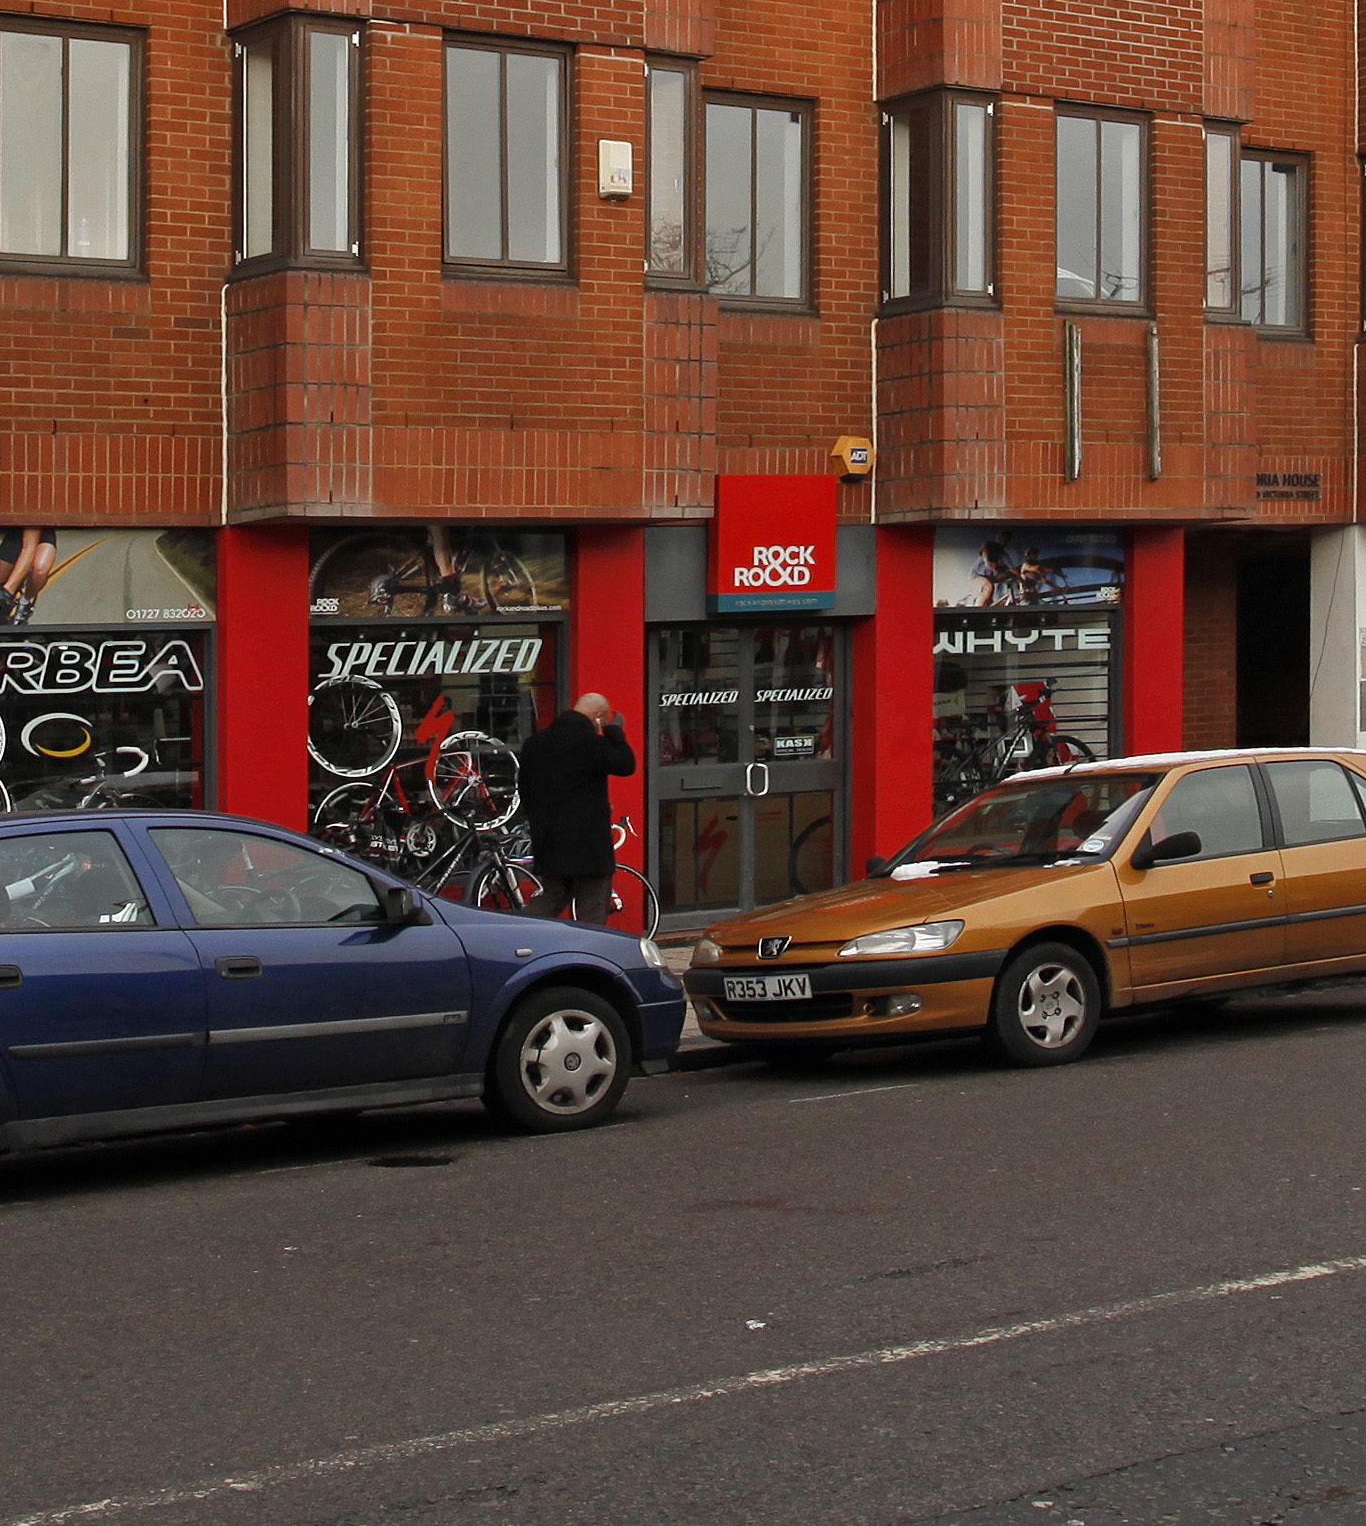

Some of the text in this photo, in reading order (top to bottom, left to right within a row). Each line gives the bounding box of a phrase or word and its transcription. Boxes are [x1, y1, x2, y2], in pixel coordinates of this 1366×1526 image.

[1283, 473, 1320, 487] HOUSE
[753, 545, 815, 567] ROCK
[126, 608, 161, 620] 01727
[933, 628, 1111, 654] WHYTE
[318, 639, 542, 678] SPECIALIZED
[659, 690, 739, 707] SPECIALIZED
[754, 687, 833, 703] SPECIALIZED
[727, 978, 807, 998] R353 JKV
